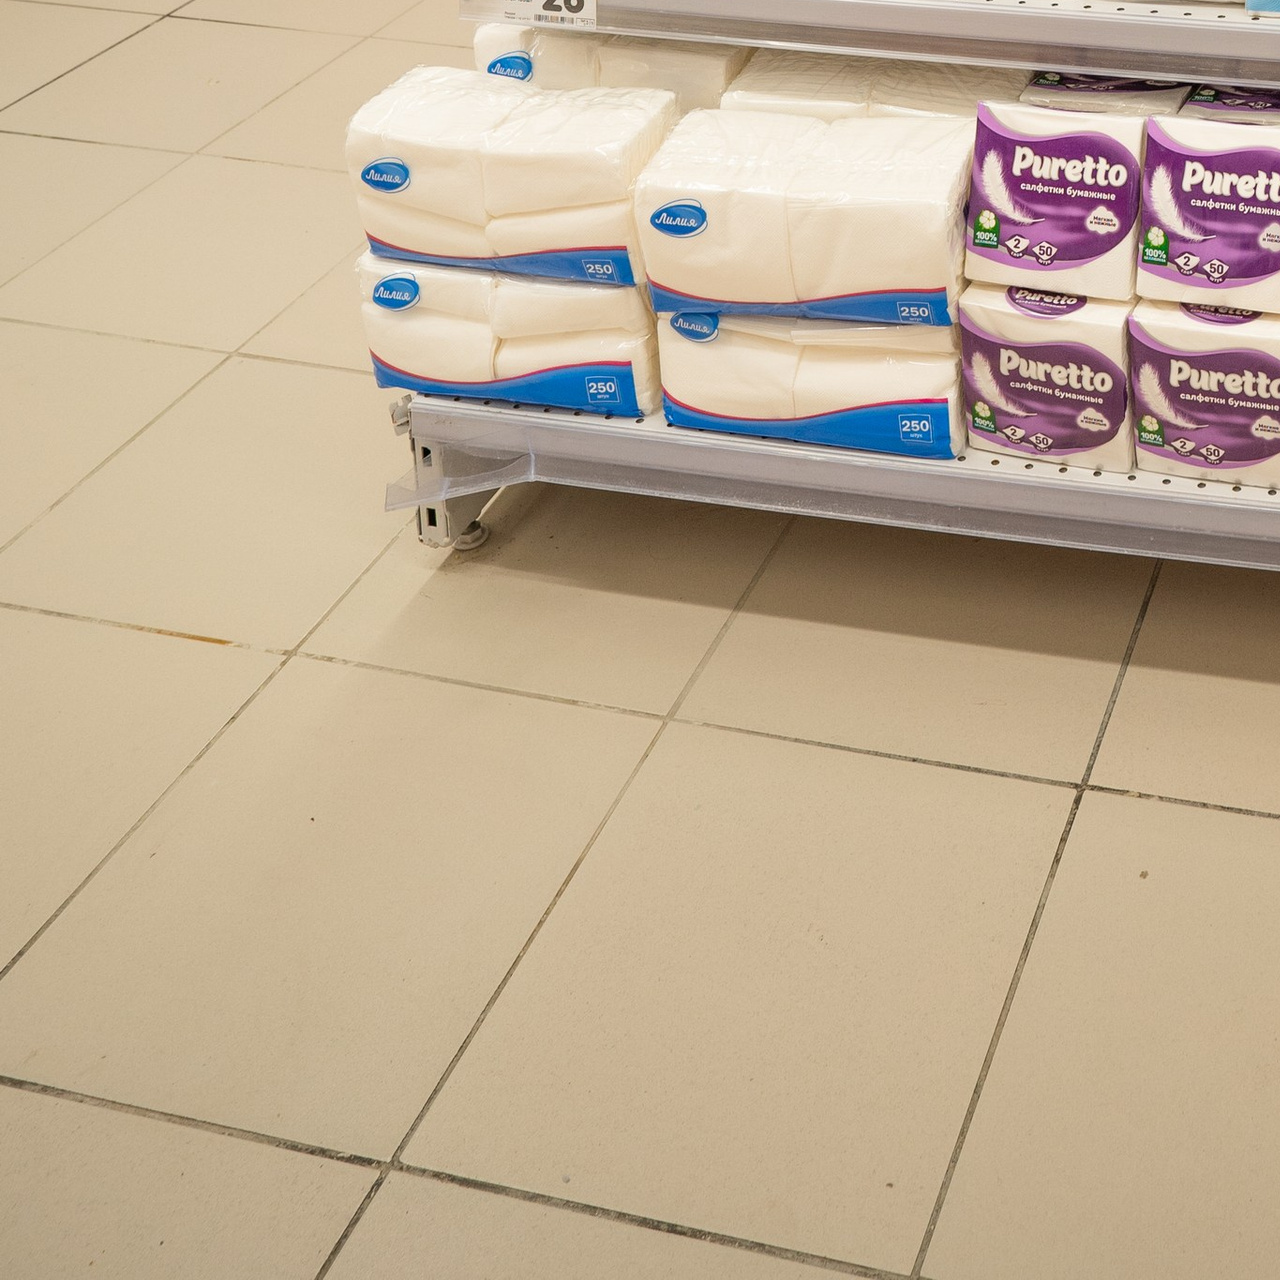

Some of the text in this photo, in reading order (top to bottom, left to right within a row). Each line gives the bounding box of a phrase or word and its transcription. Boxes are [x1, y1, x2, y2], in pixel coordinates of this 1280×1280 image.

[1011, 145, 1128, 186] Puretto
[365, 168, 402, 185] Лилия
[1020, 183, 1116, 201] салфетки бумажные
[655, 209, 698, 229] Лилия
[975, 232, 998, 242] 100%
[586, 262, 612, 276] 250
